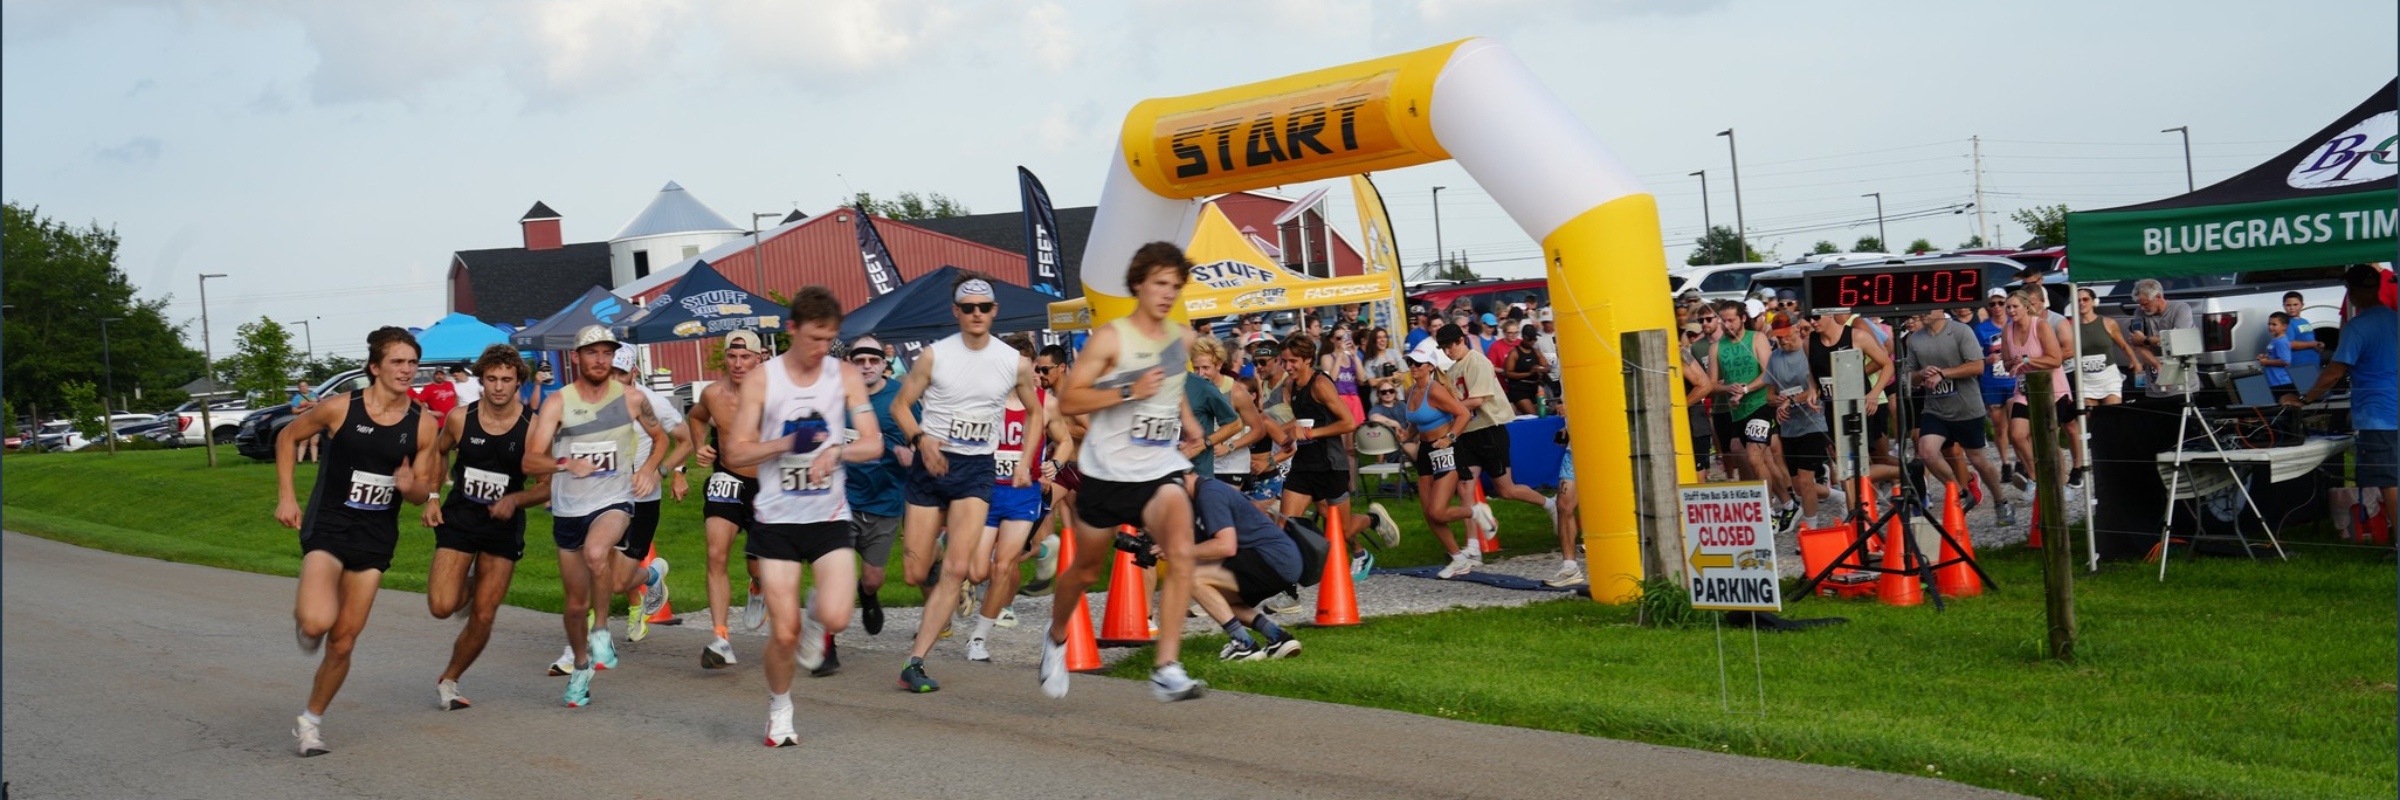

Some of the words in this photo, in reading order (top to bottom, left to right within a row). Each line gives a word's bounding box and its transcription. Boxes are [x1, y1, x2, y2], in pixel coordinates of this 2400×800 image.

[1172, 93, 1370, 178] START
[2143, 213, 2333, 256] BLUEGRASS
[1036, 224, 1056, 278] FEET
[862, 251, 894, 295] FEET
[1191, 261, 1274, 283] STUFF
[680, 289, 748, 309] STUFF
[1304, 283, 1381, 300] FASTSIGNS
[951, 419, 992, 441] 5044
[1745, 425, 1770, 439] 5034
[572, 452, 615, 471] 121
[1431, 454, 1455, 471] 5120
[350, 482, 395, 505] 5126
[464, 479, 505, 500] 5123
[707, 480, 741, 499] 5301
[1687, 502, 1763, 524] ENTRANCE
[1699, 525, 1755, 546] CLOSED
[1693, 578, 1774, 603] PARKING
